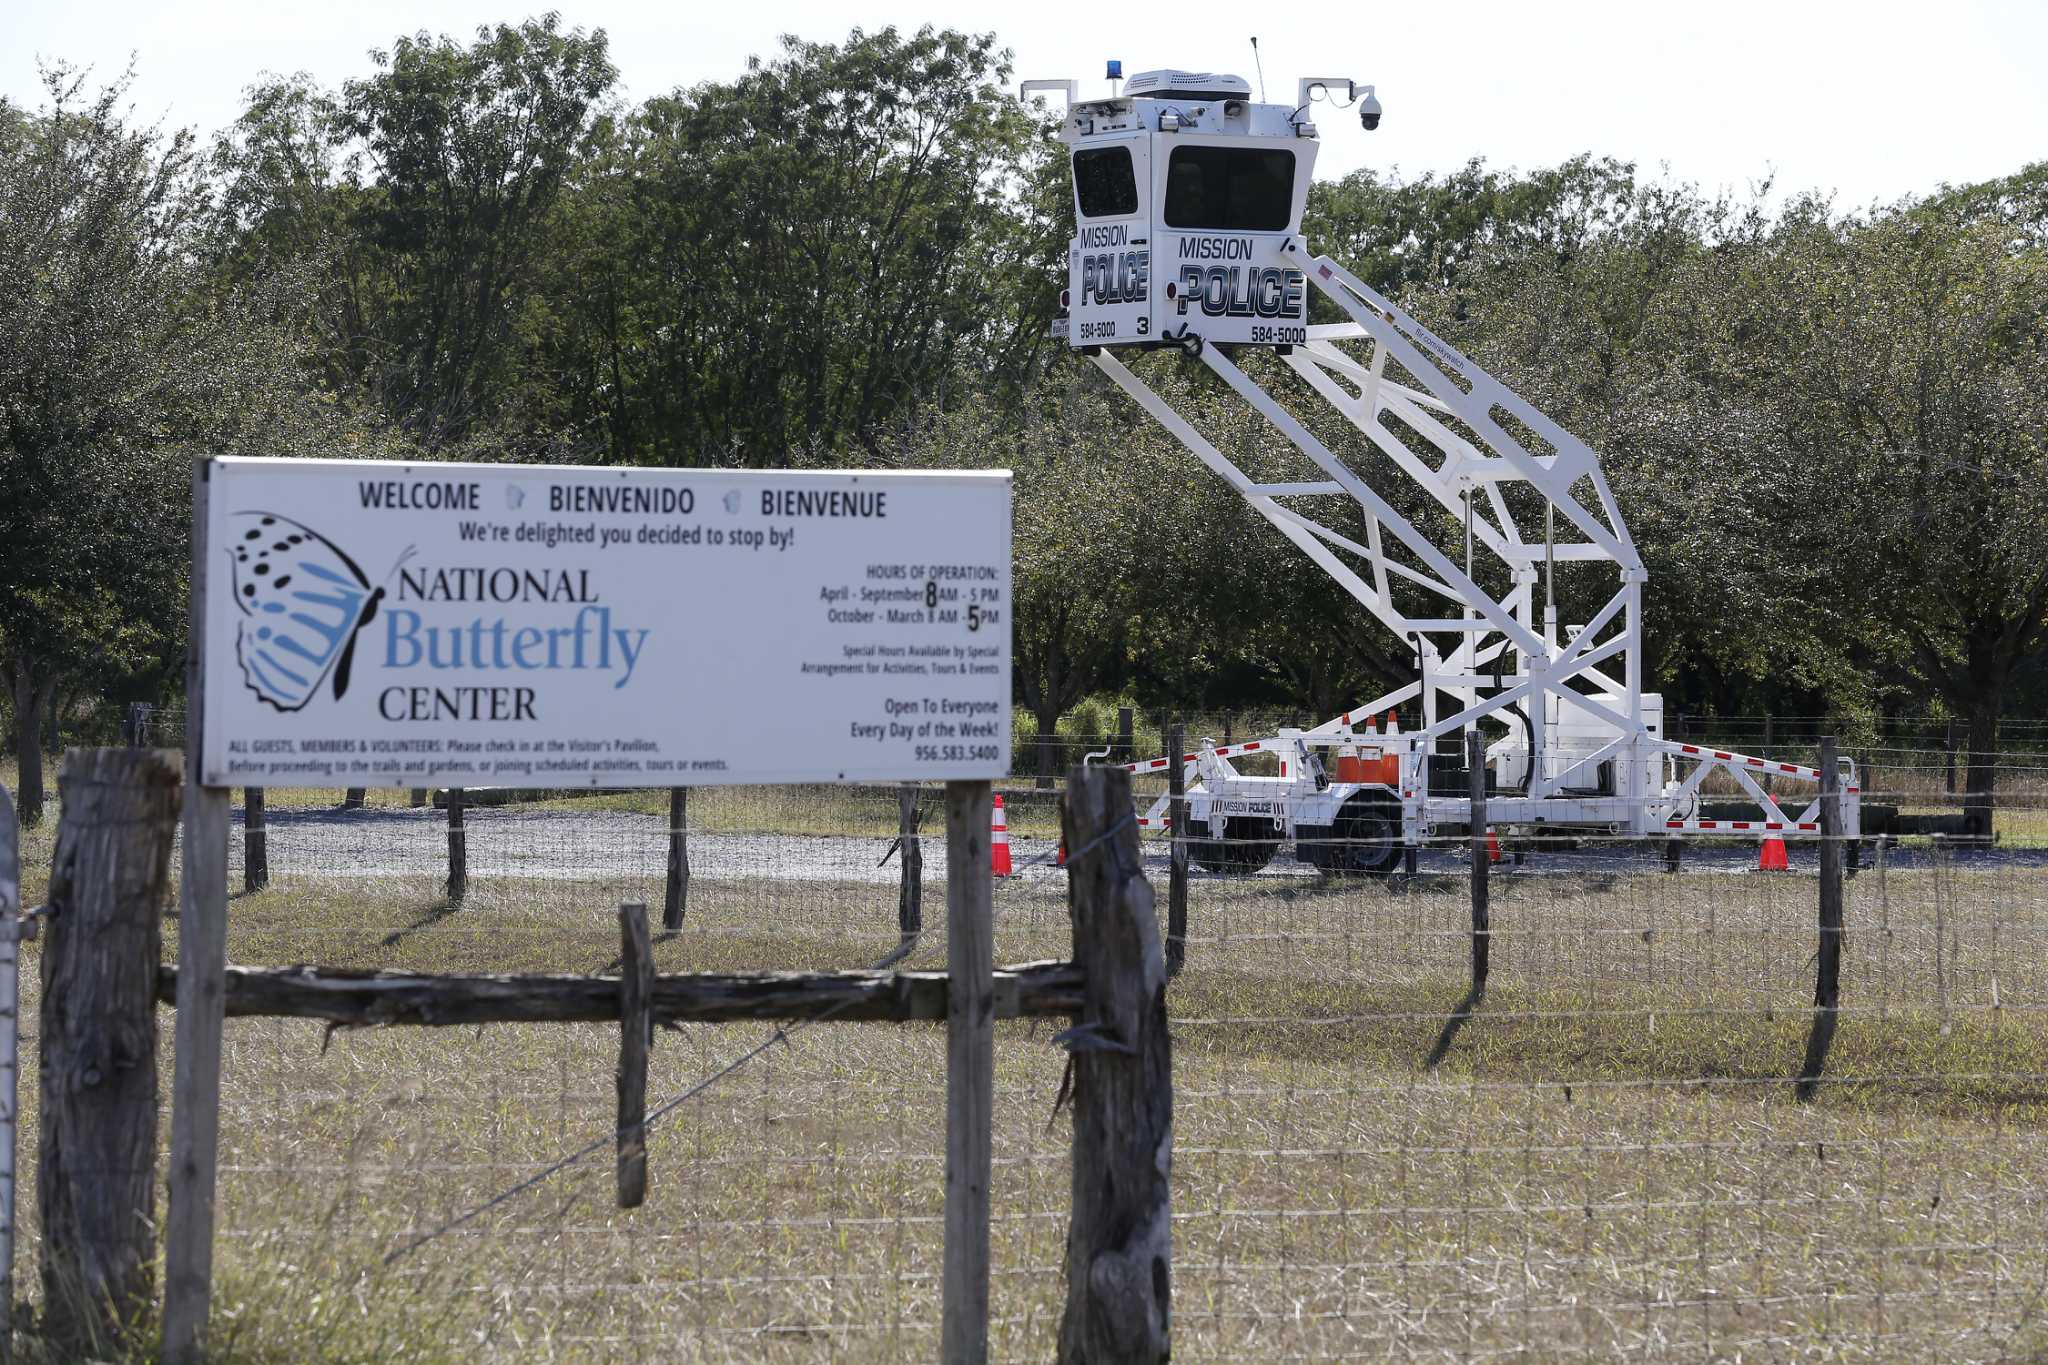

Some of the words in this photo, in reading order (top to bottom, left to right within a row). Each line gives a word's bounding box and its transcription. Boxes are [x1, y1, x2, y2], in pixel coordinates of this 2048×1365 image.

[1080, 225, 1128, 249] MISSION
[1178, 237, 1253, 260] MISSION
[1081, 250, 1149, 306] POLICE
[1177, 264, 1305, 319] POLICE
[1080, 321, 1116, 339] 584-5000
[1136, 316, 1149, 335] 3
[1251, 326, 1306, 344] 584-5000
[359, 481, 480, 510] WELCOME
[549, 485, 695, 514] BIENVENIDO
[761, 490, 887, 518] BIENVENUE
[459, 521, 509, 542] We're
[515, 522, 595, 548] delighted
[600, 530, 632, 549] you
[637, 525, 701, 545] decided
[707, 529, 724, 545] to
[729, 528, 764, 550] stop
[769, 526, 794, 551] by!
[866, 565, 907, 579] HOURS
[910, 566, 925, 579] OF
[929, 566, 999, 581] OPERATION:
[399, 567, 599, 603] NATIONAL
[820, 586, 849, 604] April
[860, 586, 924, 605] September
[926, 581, 937, 608] 8
[939, 588, 958, 601] AM
[971, 588, 977, 602] 5
[981, 588, 999, 602] PM
[827, 609, 875, 624] October
[887, 609, 924, 624] March
[938, 610, 958, 624] AM
[968, 605, 980, 632] 5
[981, 610, 999, 624] PM
[382, 605, 650, 689] Butterfly
[843, 645, 875, 659] Special
[878, 645, 905, 657] Hours
[908, 645, 951, 657] Available
[954, 645, 964, 660] by
[968, 646, 999, 659] Special
[801, 662, 864, 676] Arrangement
[866, 662, 880, 674] for
[883, 662, 928, 676] Activities,
[931, 663, 957, 675] Tours
[959, 663, 967, 674] &
[969, 663, 999, 675] Events
[378, 687, 538, 721] CENTER
[885, 699, 919, 718] Open
[922, 700, 938, 714] To
[941, 699, 999, 718] Everyone
[851, 722, 886, 742] Every
[890, 722, 914, 742] Day
[918, 722, 931, 737] of
[934, 722, 955, 737] the
[959, 722, 999, 738] Week!
[229, 740, 248, 753] ALL
[252, 739, 298, 755] GUESTS,
[301, 739, 356, 752] MEMBERS
[359, 740, 368, 753] &
[447, 739, 482, 752] Please
[485, 740, 515, 752] check
[519, 740, 530, 752] in
[533, 740, 545, 752] at
[548, 739, 565, 752] the
[569, 739, 611, 752] Visitor's
[615, 739, 660, 754] Pavilion,
[915, 745, 999, 761] 956.583.5400
[229, 760, 265, 772] Before
[269, 760, 333, 776] proceeding
[335, 761, 347, 772] to
[351, 759, 369, 772] the
[372, 759, 401, 772] trails
[405, 759, 427, 772] and
[428, 758, 475, 776] gardens,
[479, 761, 491, 772] or
[494, 759, 532, 775] joining
[535, 759, 588, 771] scheduled
[592, 759, 643, 773] activities,
[646, 759, 673, 771] tours
[677, 761, 688, 770] or
[692, 759, 728, 771] events.
[1223, 800, 1248, 813] MISSION
[1248, 801, 1272, 813] POLICE
